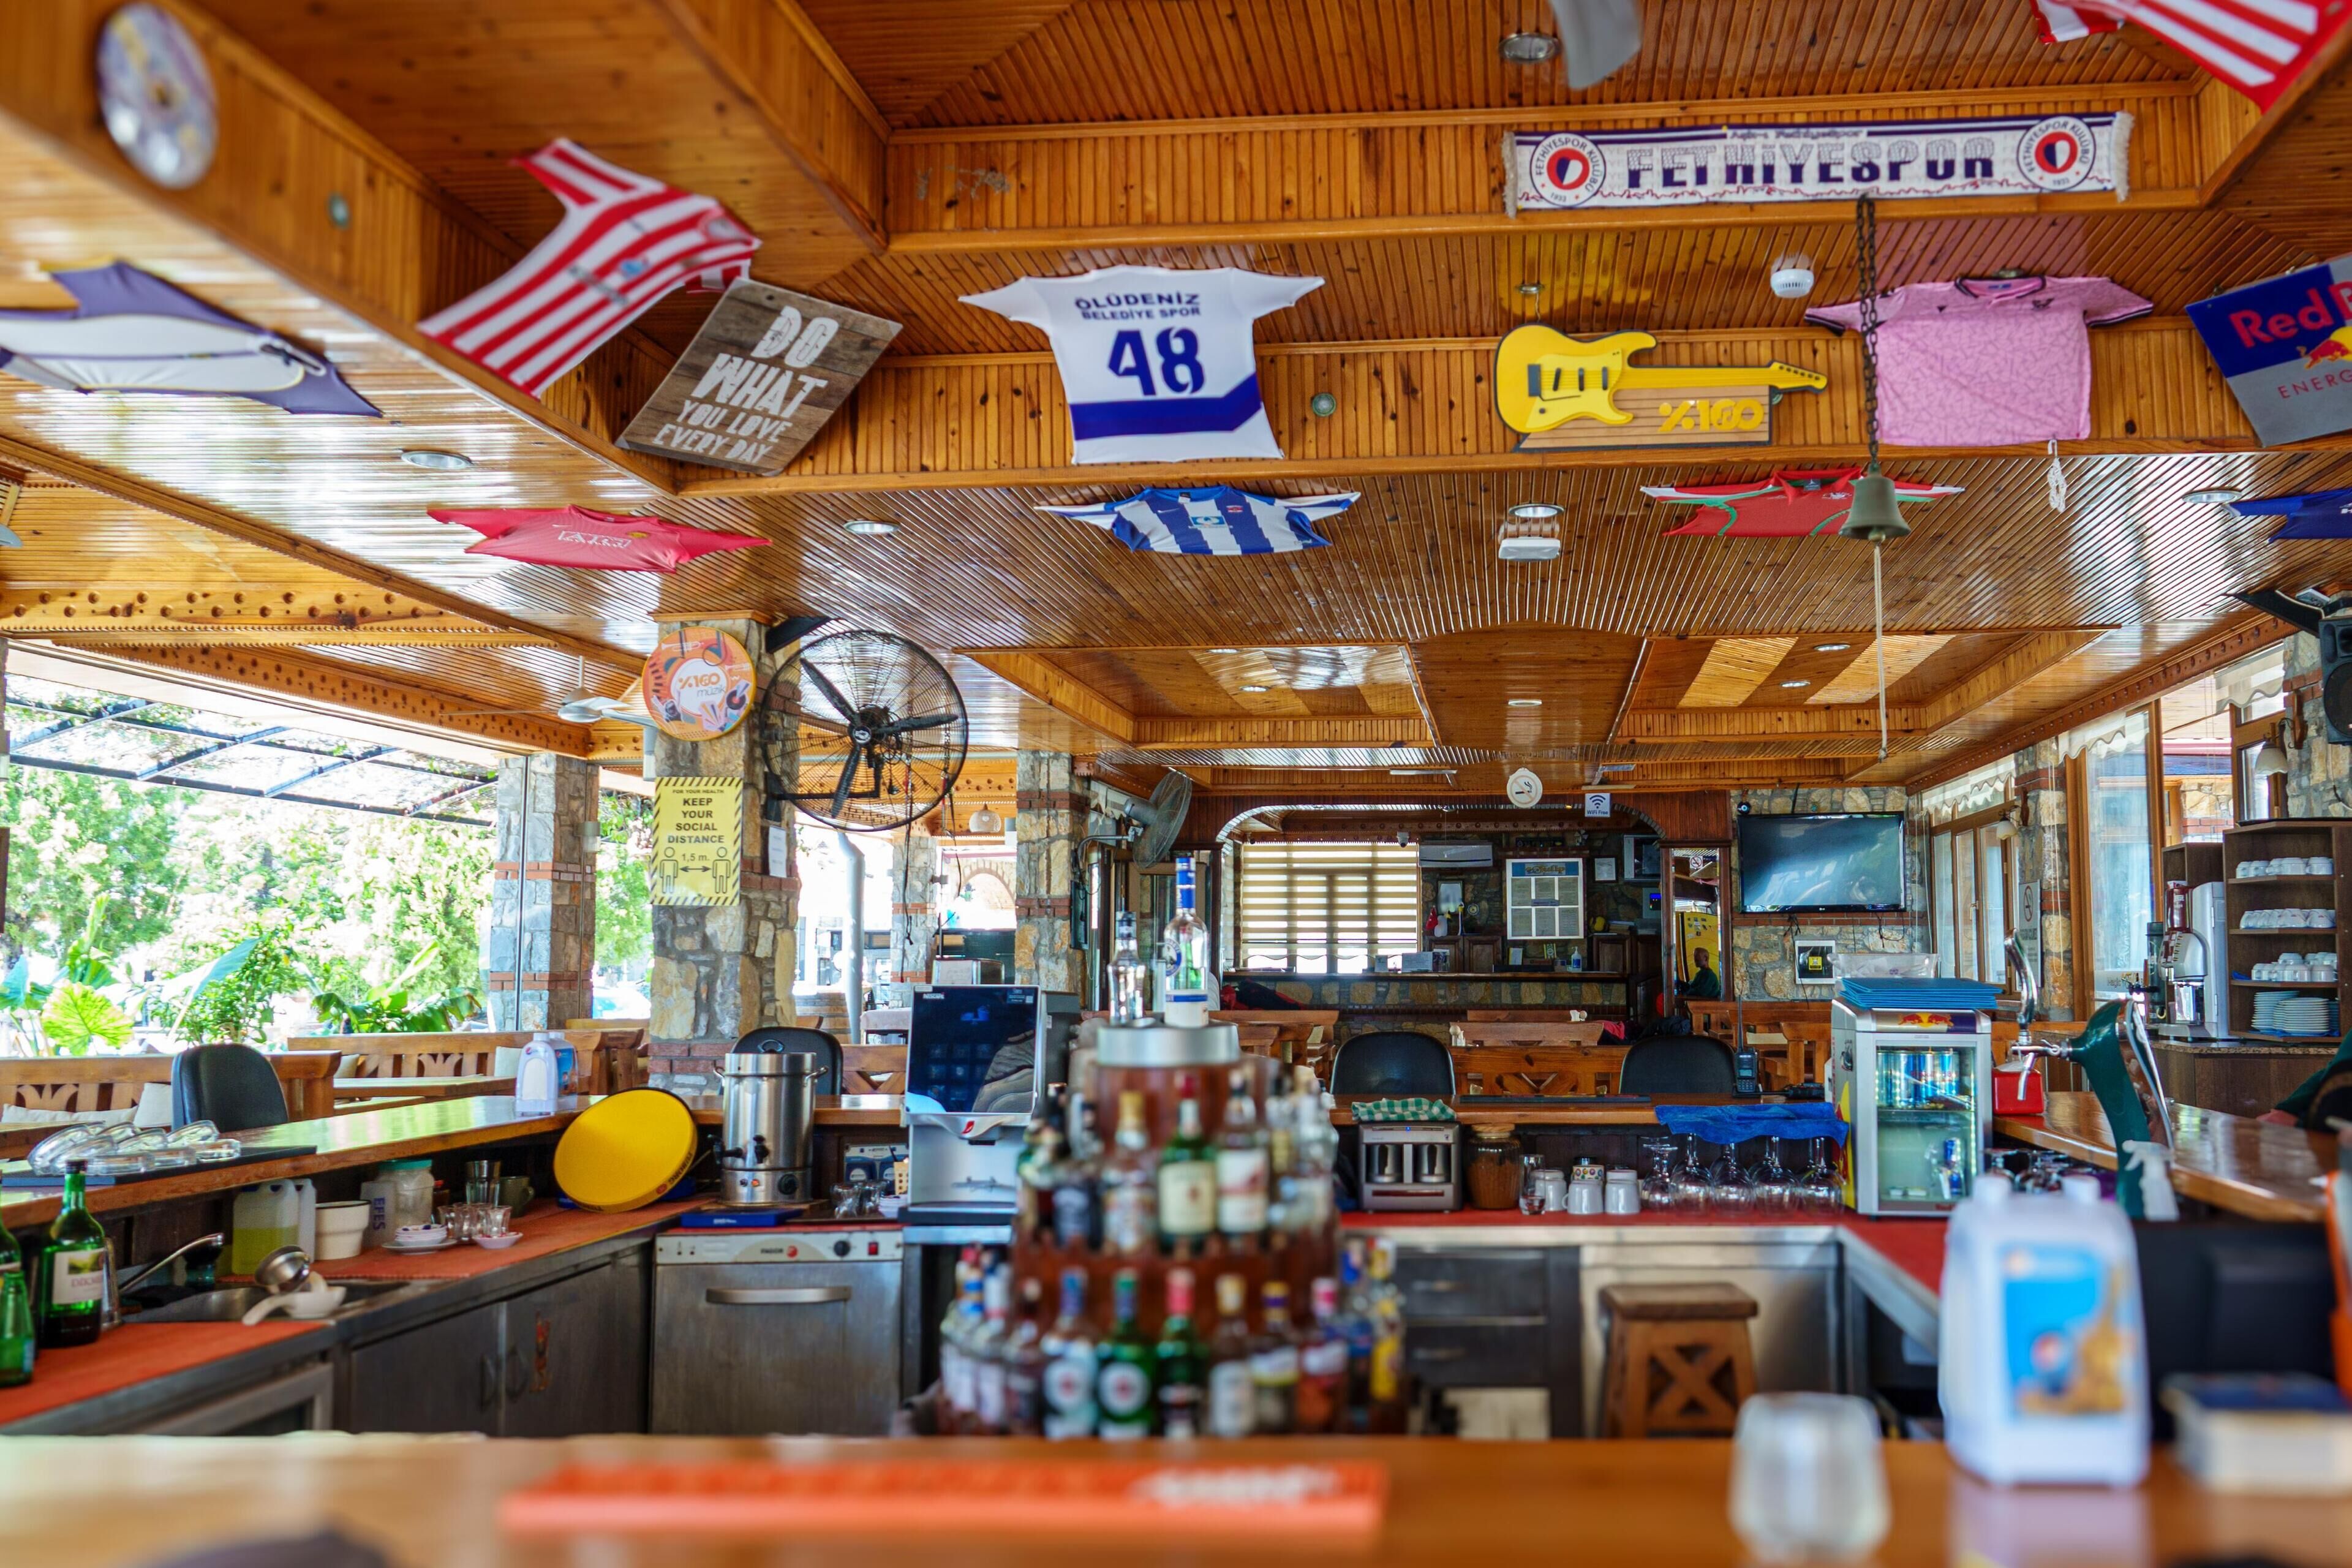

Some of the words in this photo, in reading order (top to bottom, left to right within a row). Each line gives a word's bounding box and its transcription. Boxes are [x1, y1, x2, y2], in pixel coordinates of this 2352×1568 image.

[1074, 290, 1200, 310] ÖLÜDENİZ
[1081, 309, 1155, 320] BELEDİYE
[1159, 307, 1201, 318] SPOR
[2228, 287, 2334, 349] Red
[750, 305, 839, 368] DO
[1107, 326, 1205, 396] 48
[691, 352, 828, 418] WHAT
[676, 399, 729, 429] YOU
[726, 412, 793, 443] LOVE
[652, 423, 731, 456] EVERY
[725, 439, 772, 464] DAY
[668, 835, 725, 843] DISTANCE
[682, 853, 696, 862] 1,5
[372, 1197, 386, 1231] EFES
